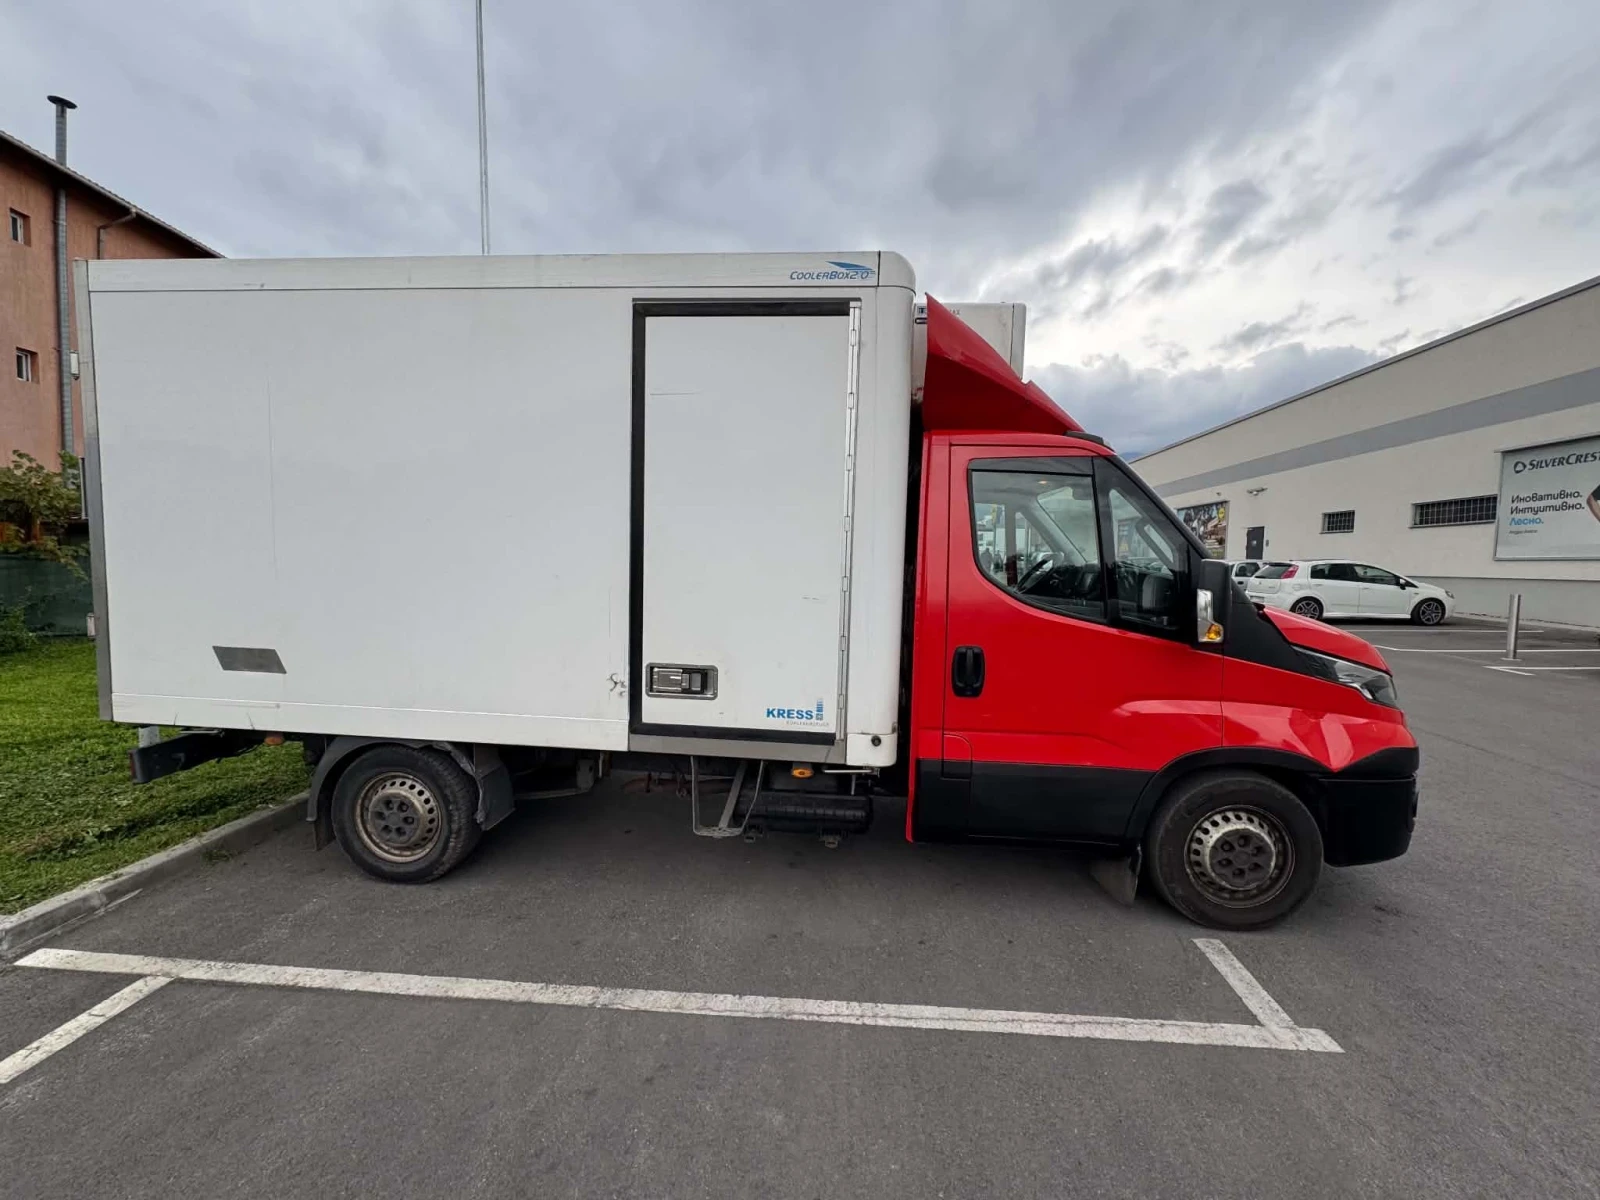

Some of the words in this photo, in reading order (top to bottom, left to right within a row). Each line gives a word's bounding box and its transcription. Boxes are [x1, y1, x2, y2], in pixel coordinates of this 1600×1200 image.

[1528, 452, 1600, 470] SILVERCRES
[1511, 490, 1583, 503] Иновативно.
[1510, 501, 1585, 515] Интуитивно.
[766, 708, 814, 720] KRESS
